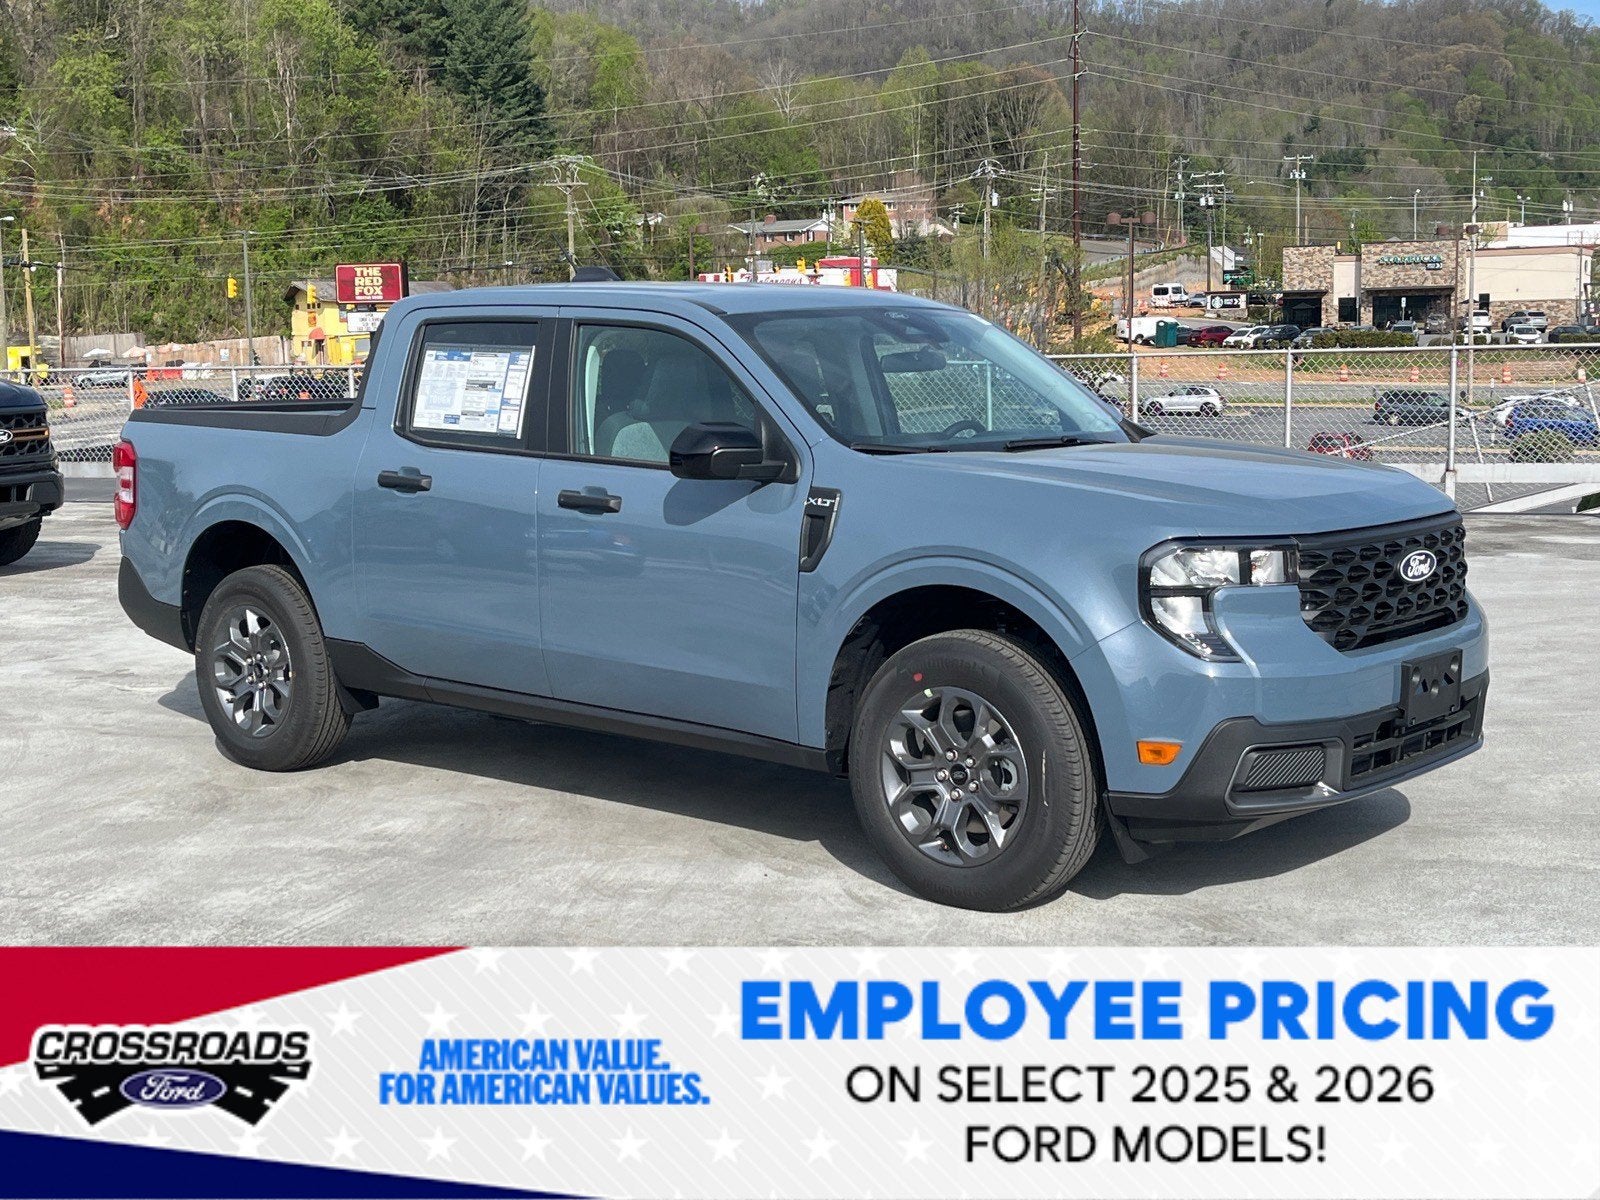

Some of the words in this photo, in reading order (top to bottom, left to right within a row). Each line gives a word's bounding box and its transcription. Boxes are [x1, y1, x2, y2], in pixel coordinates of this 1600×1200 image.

[354, 267, 382, 277] THE
[354, 276, 383, 287] RED
[355, 286, 383, 296] FOX
[1407, 554, 1431, 578] Ford
